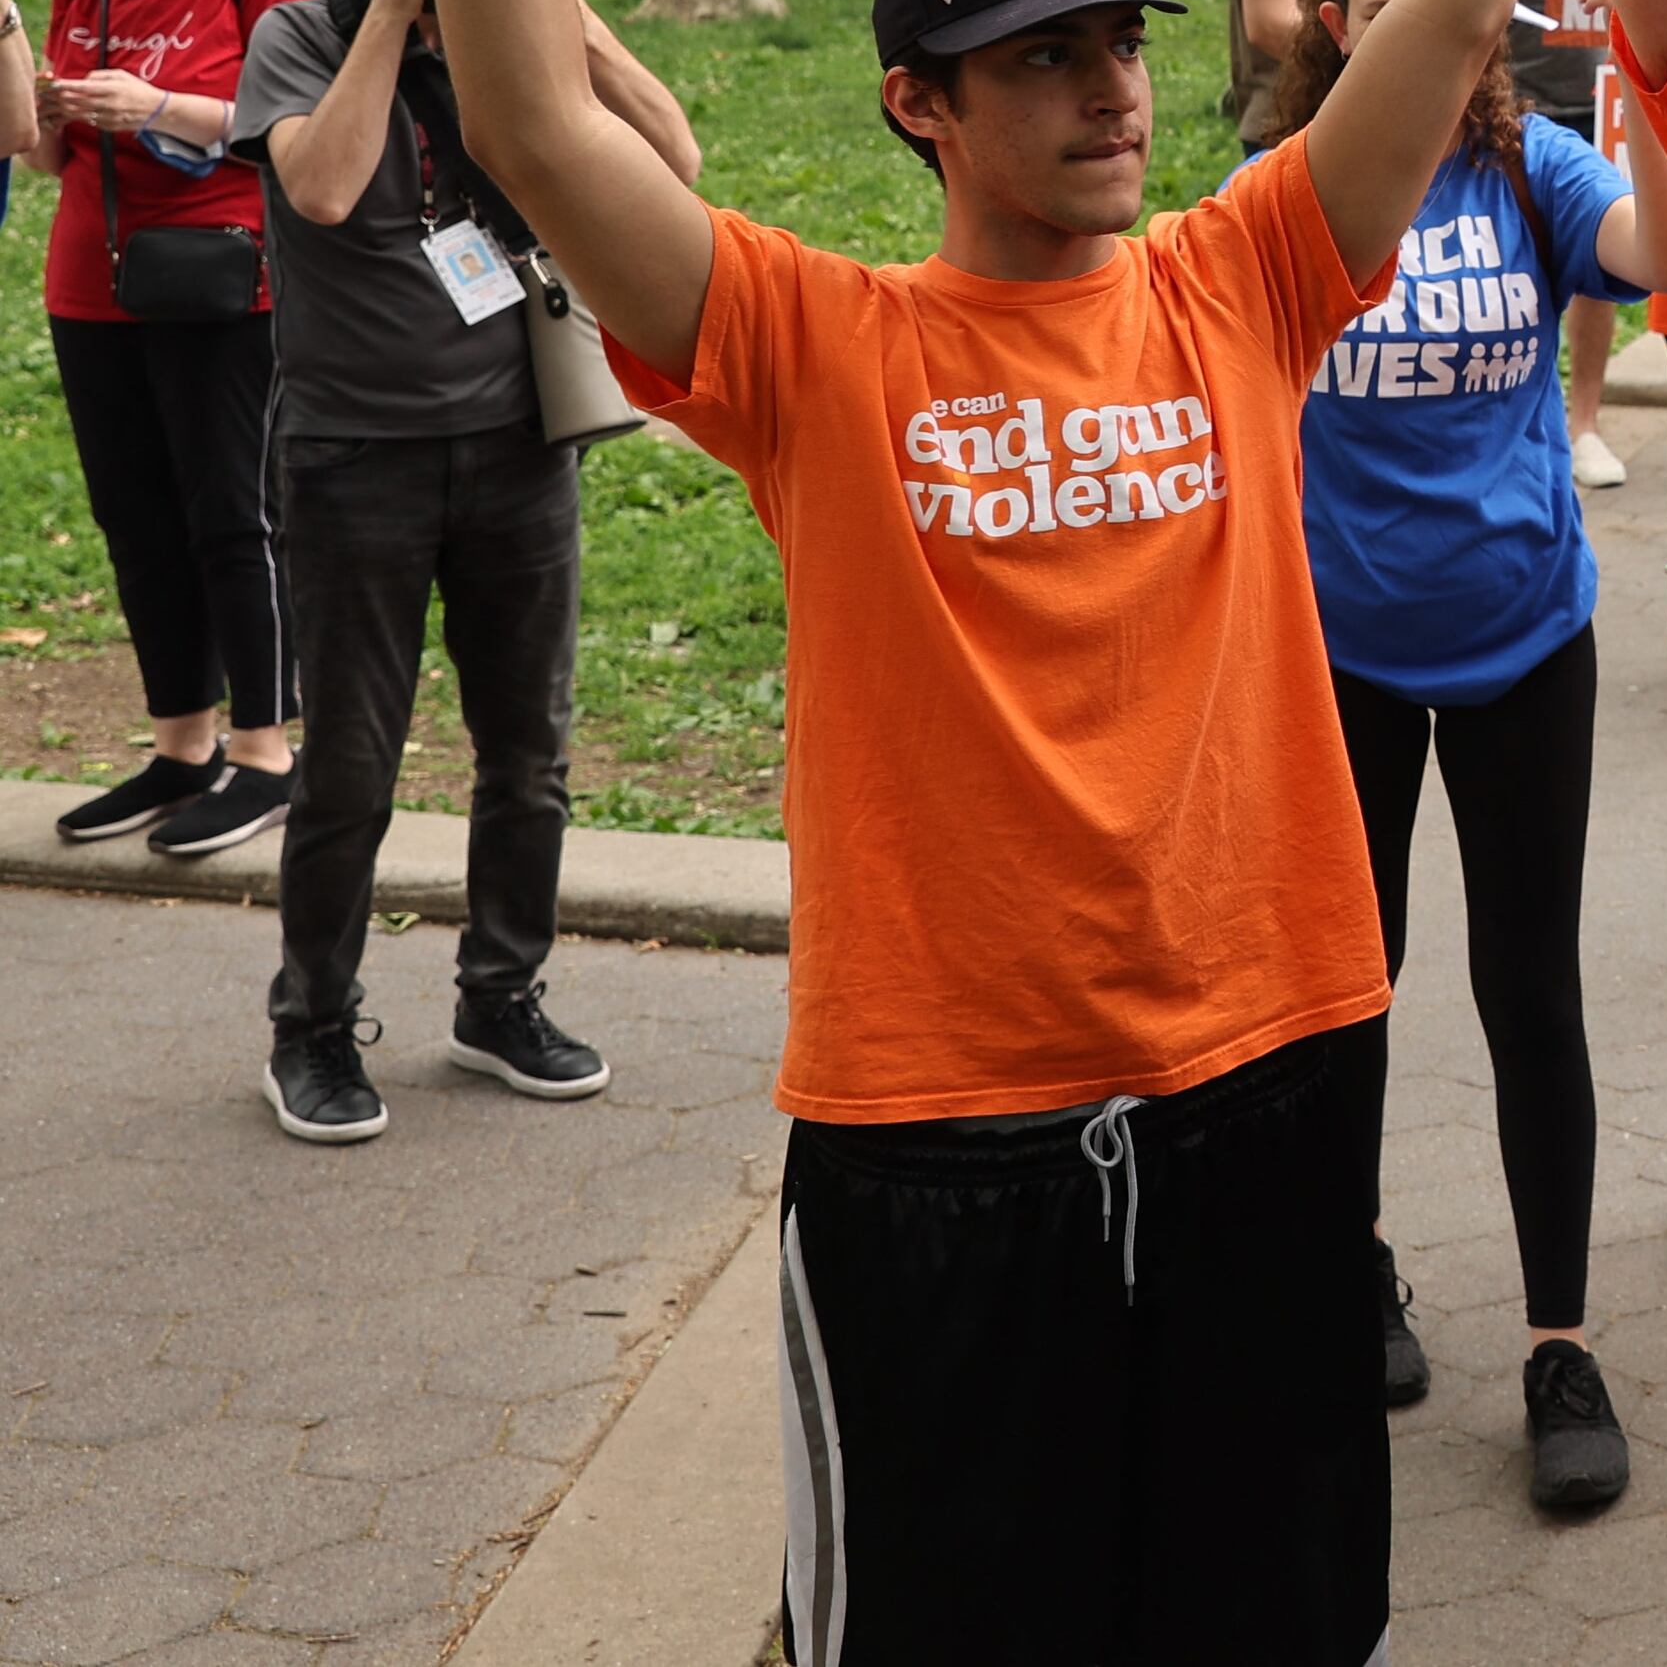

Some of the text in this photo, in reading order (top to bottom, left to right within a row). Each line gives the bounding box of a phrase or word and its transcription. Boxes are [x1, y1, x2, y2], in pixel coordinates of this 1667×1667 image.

[1416, 273, 1540, 333] OUR
[905, 395, 1213, 475] end gun
[951, 390, 1007, 417] can
[902, 450, 1230, 538] violence
